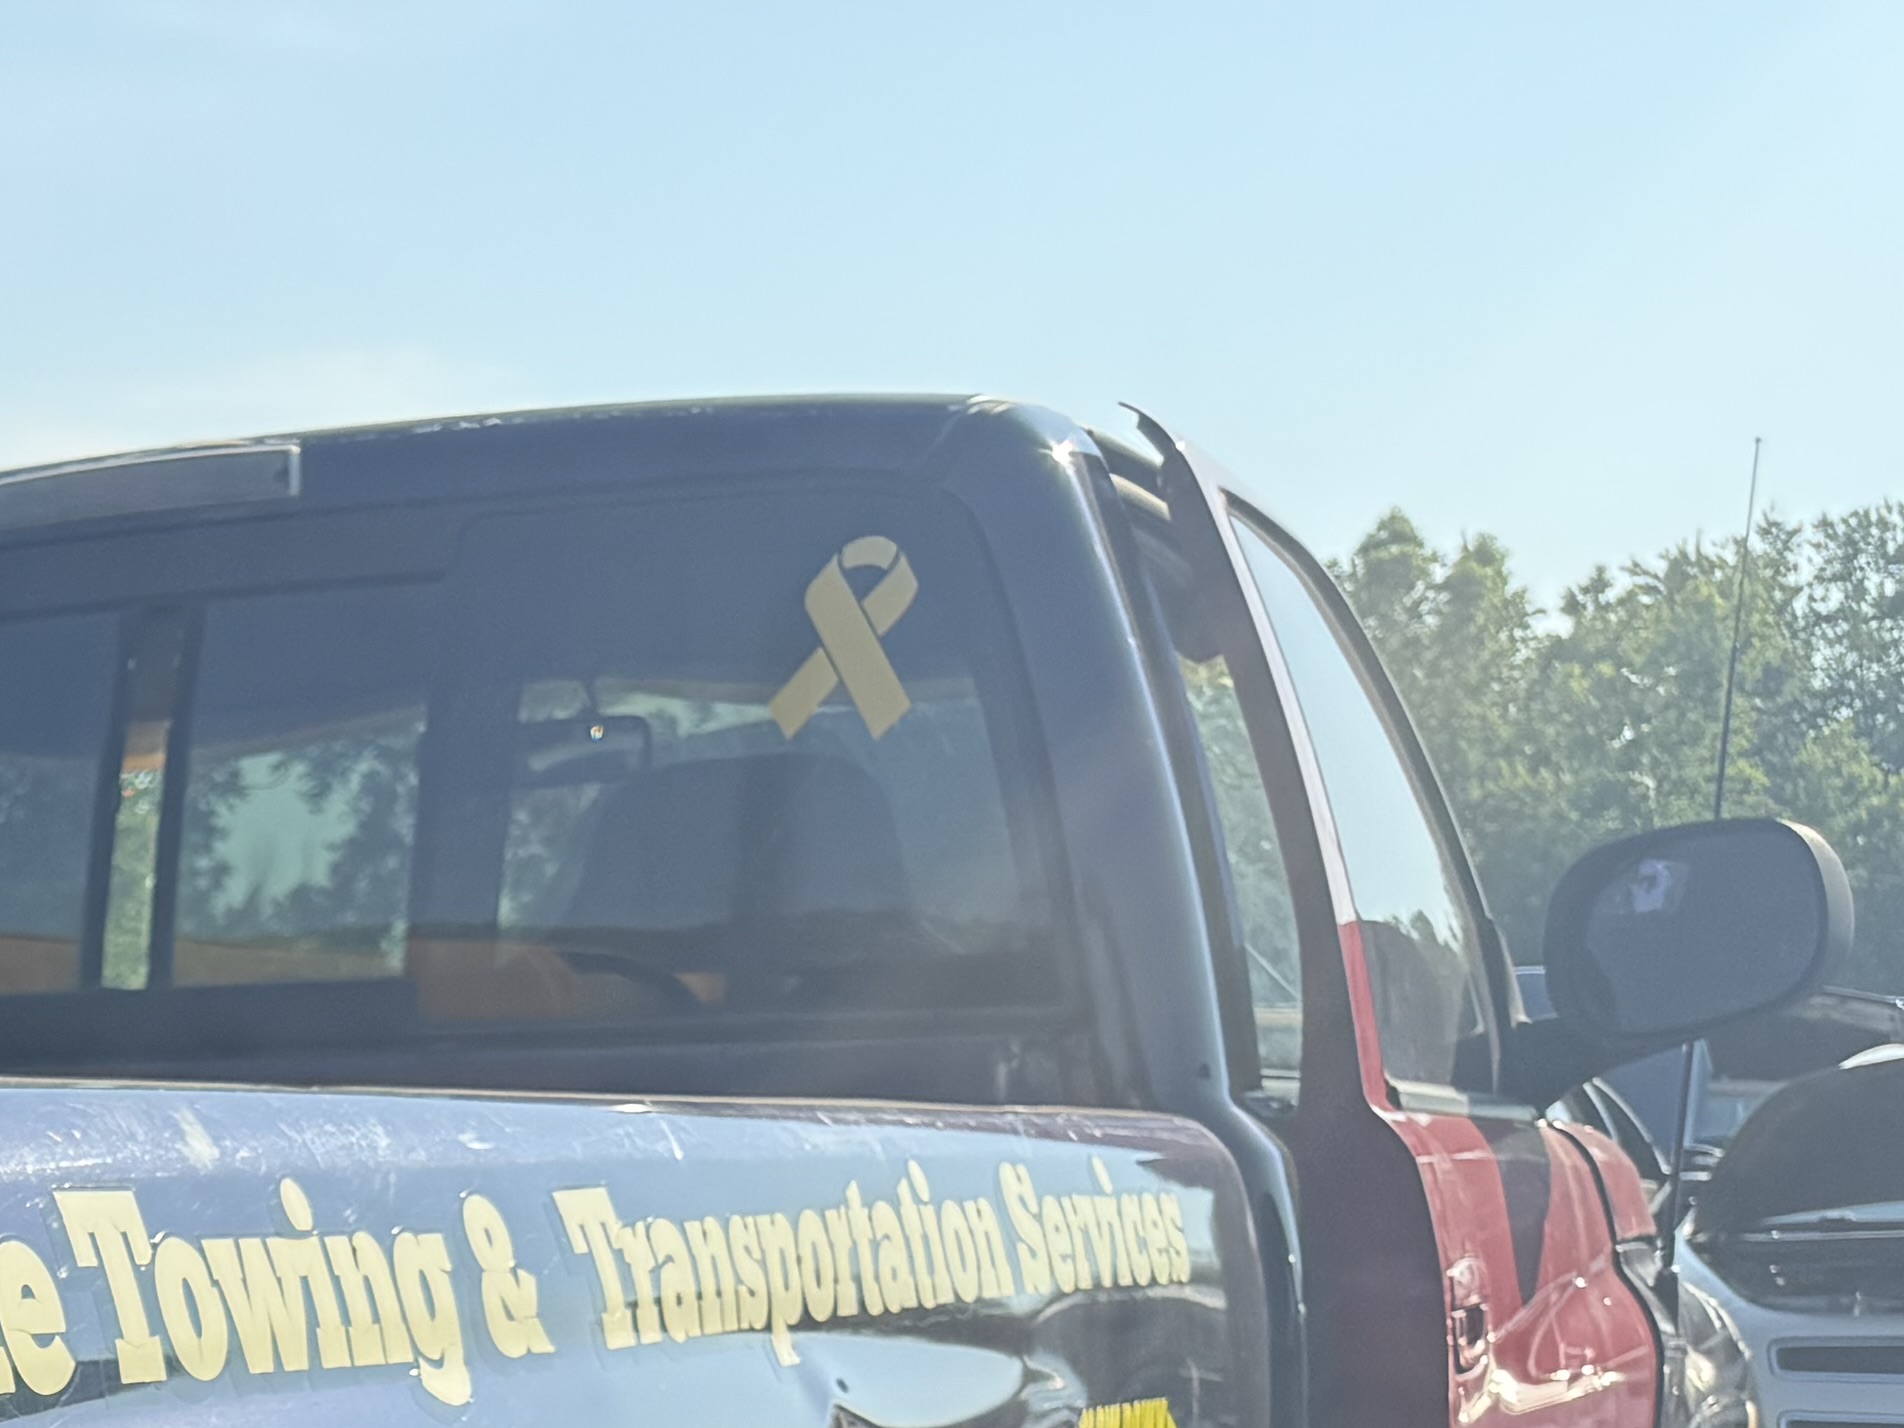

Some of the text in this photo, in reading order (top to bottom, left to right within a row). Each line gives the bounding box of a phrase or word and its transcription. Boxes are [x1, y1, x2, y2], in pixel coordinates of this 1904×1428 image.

[53, 1177, 473, 1405] Towing
[462, 1192, 555, 1358] &
[553, 1161, 1014, 1367] Transportation
[998, 1156, 1189, 1296] Services
